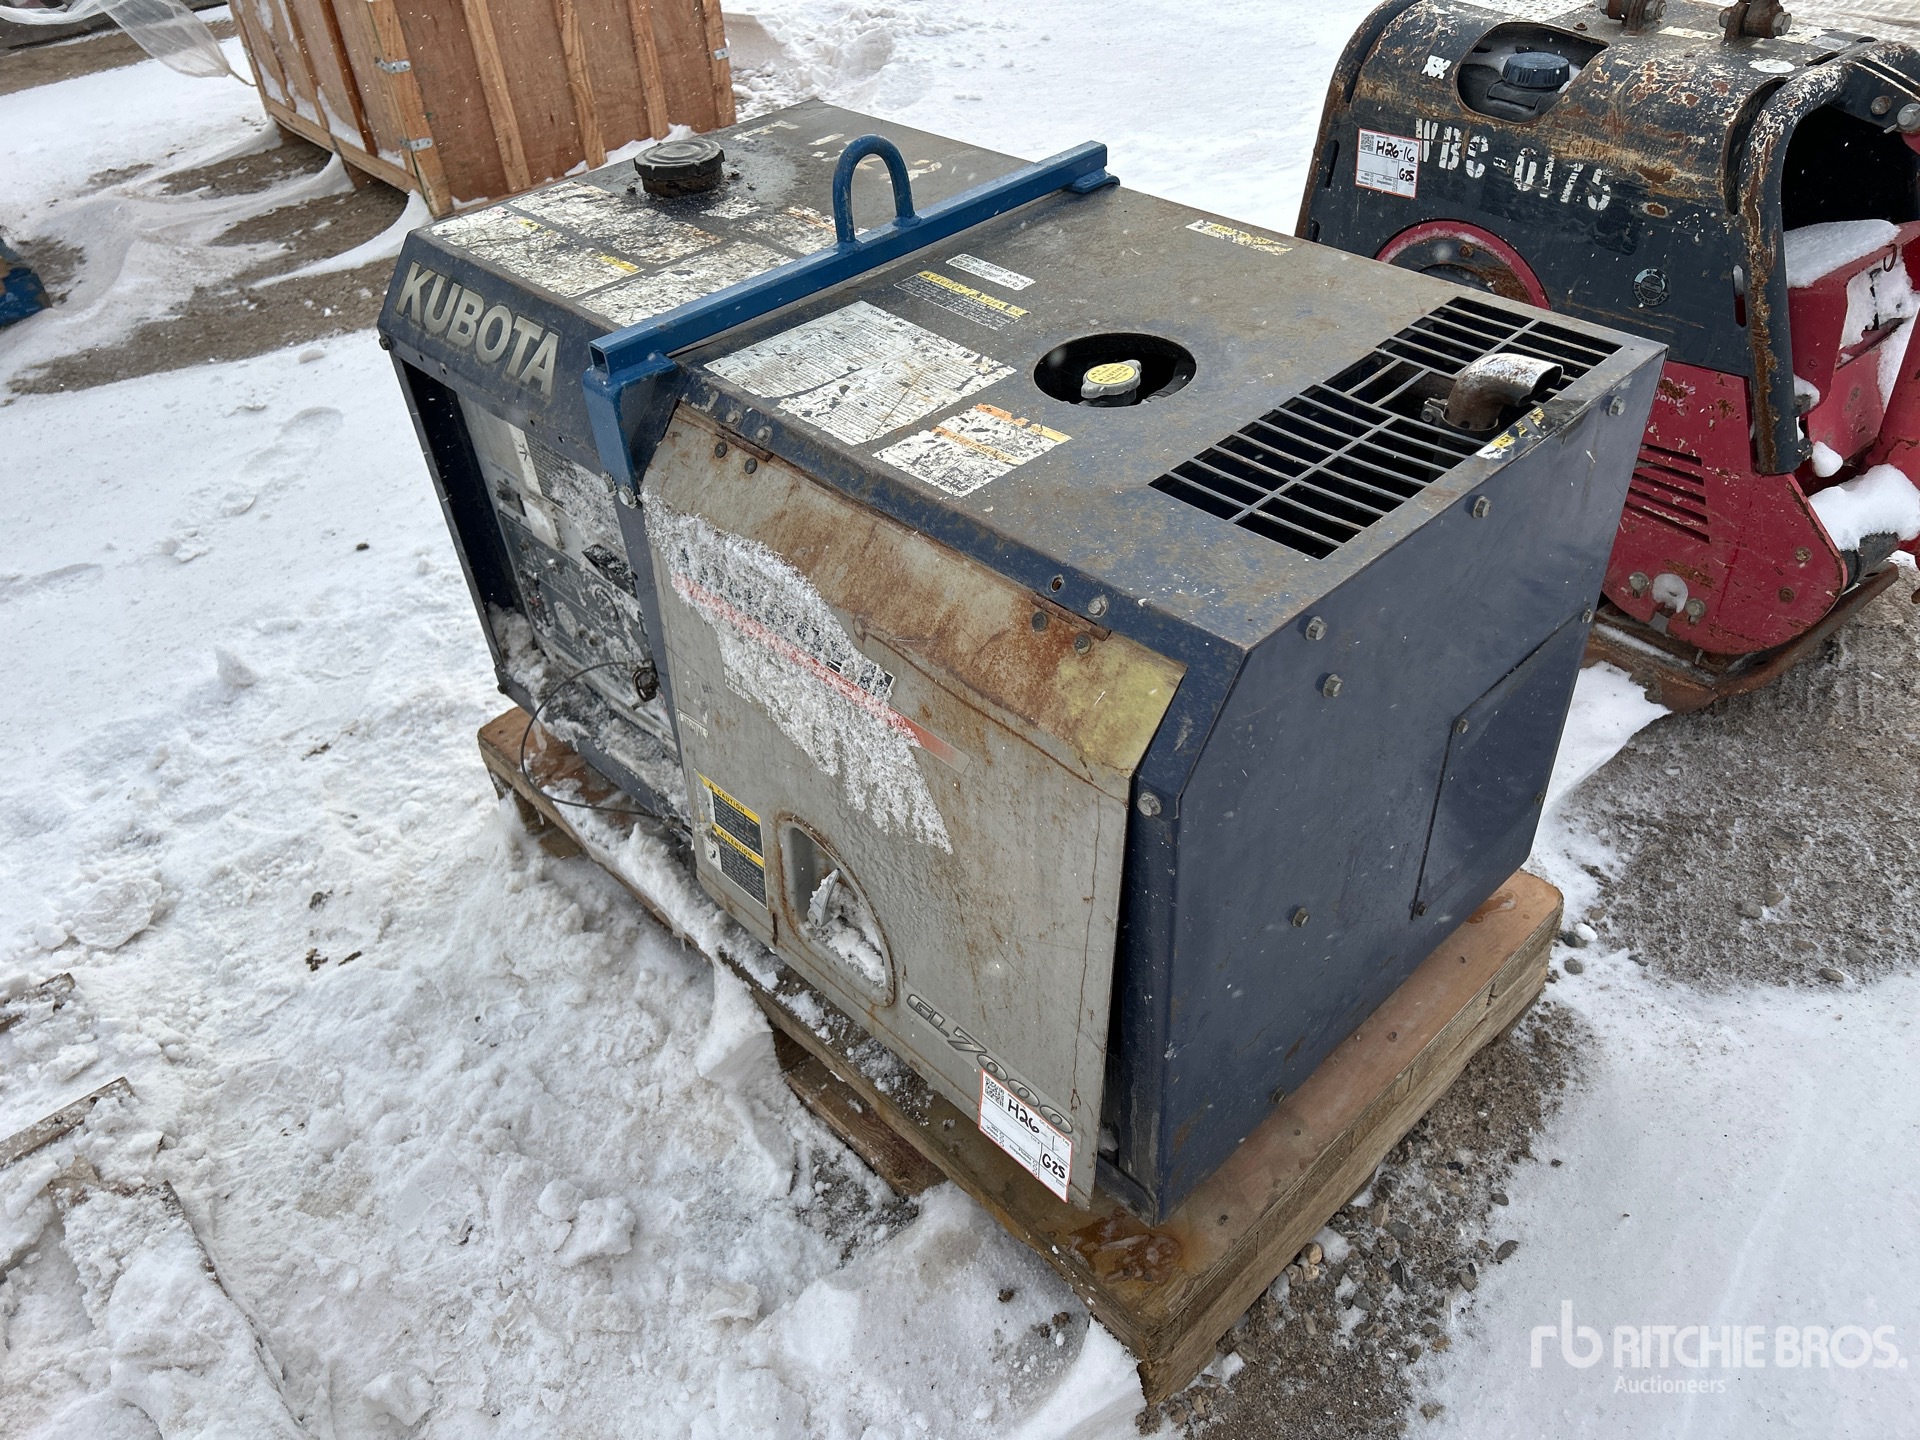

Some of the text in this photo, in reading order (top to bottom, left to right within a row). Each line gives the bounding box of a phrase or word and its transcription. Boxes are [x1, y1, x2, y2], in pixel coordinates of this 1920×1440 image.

[1376, 140, 1415, 163] H26-16
[395, 262, 561, 397] KUBOTA
[717, 789, 745, 813] CAUTION
[720, 831, 753, 859] ATTENTION
[906, 993, 1074, 1134] GL7000
[1042, 1153, 1066, 1179] G25
